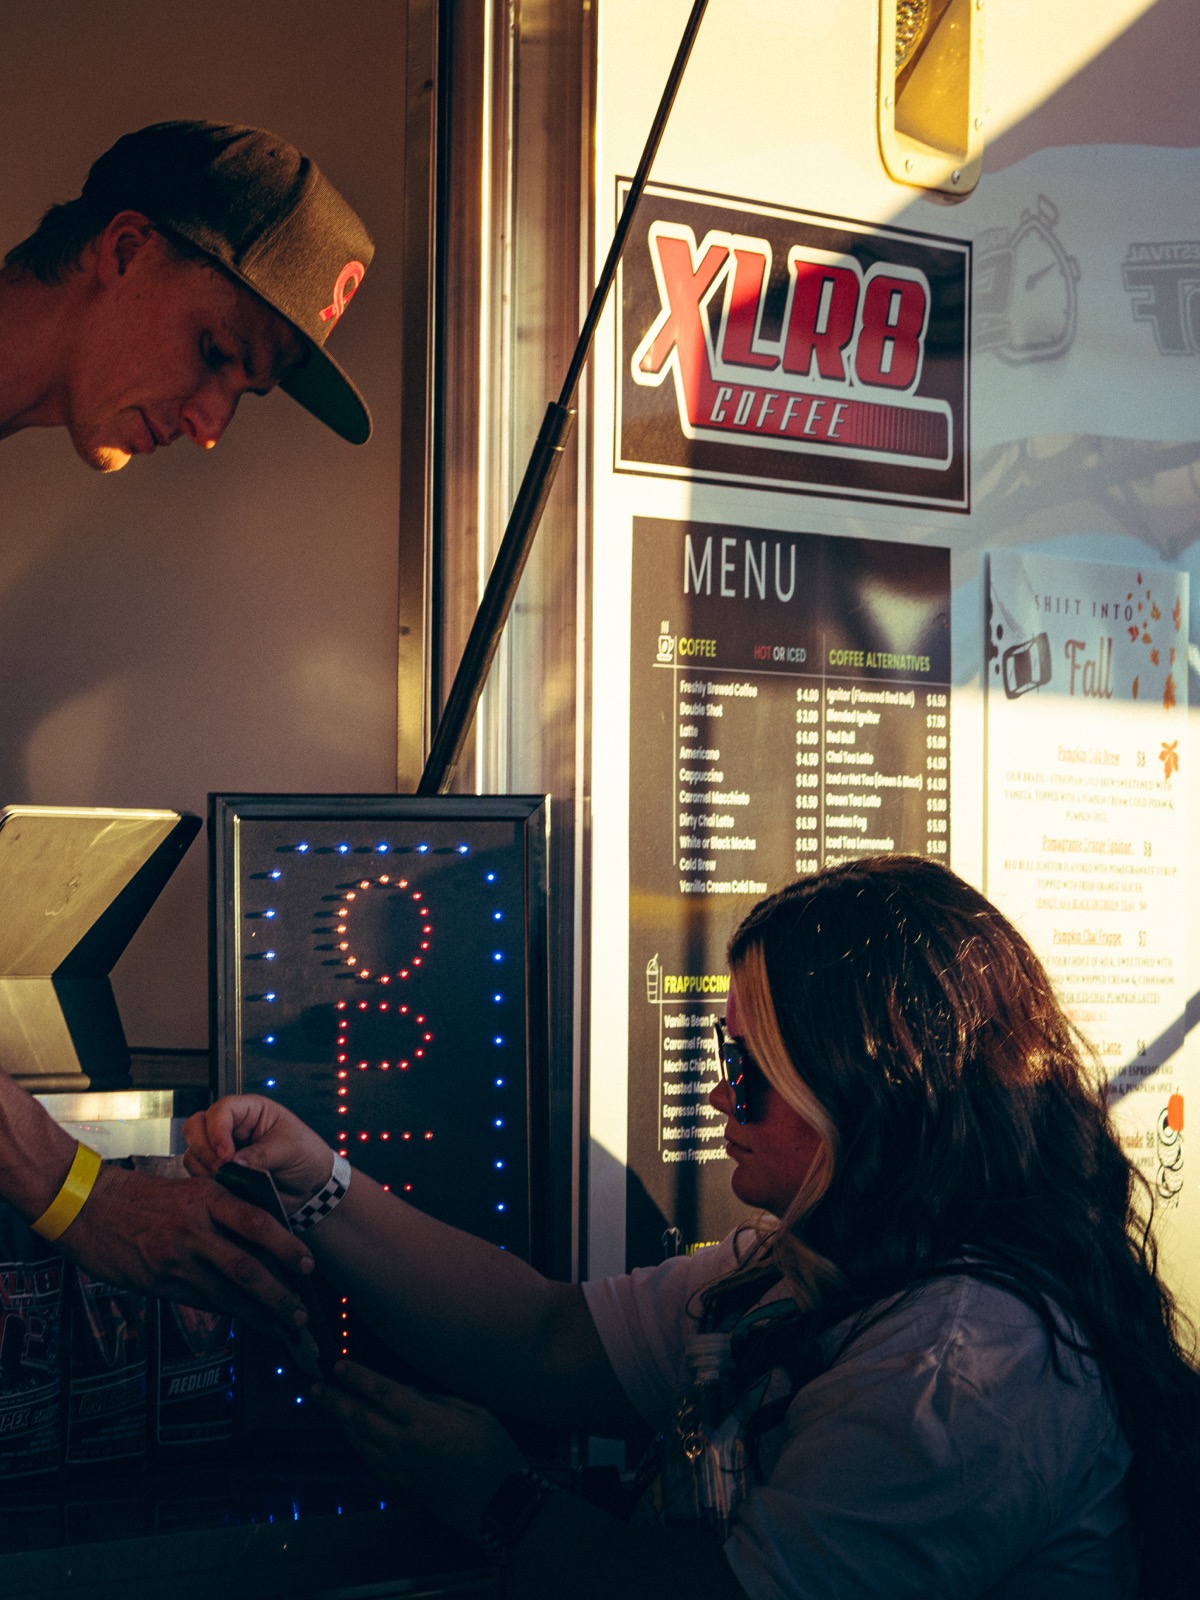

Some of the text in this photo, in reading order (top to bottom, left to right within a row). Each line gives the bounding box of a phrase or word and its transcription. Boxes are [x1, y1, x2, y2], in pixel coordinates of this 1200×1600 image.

[632, 220, 931, 430] XLR8
[709, 385, 850, 439] COFFEE
[683, 533, 797, 602] MENU
[1034, 594, 1134, 622] SHIFT INTO
[678, 638, 717, 659] COFFEE
[754, 644, 807, 663] HOT OR ICED
[829, 649, 931, 673] COFFEE ALTERNATIVES
[1063, 636, 1114, 700] Fall
[680, 680, 707, 698] Freshly
[707, 681, 734, 697] Brewed
[734, 683, 758, 698] Coffee
[680, 702, 706, 717] Double
[706, 703, 724, 718] Shot
[680, 724, 699, 738] Latte
[826, 729, 841, 744] Red
[680, 746, 721, 761] Americano
[826, 749, 843, 763] Chai
[843, 751, 856, 764] Tea
[856, 751, 874, 765] Latte
[680, 768, 724, 785] Cappuccino
[861, 773, 874, 786] Tea
[680, 790, 712, 804] Caramel
[712, 790, 751, 806] Macchiato
[825, 792, 848, 807] Green
[848, 793, 862, 807] Tea
[862, 794, 882, 808] Latte
[680, 813, 698, 831] Dirty
[698, 813, 716, 828] Chai
[715, 814, 735, 829] Latte
[825, 814, 853, 829] London
[853, 815, 868, 833] Fog
[680, 835, 701, 849] White
[702, 838, 711, 850] or
[731, 836, 757, 851] Mocha
[842, 836, 857, 850] Tea
[856, 836, 895, 851] Lemonade
[680, 857, 698, 872] Cold
[698, 858, 717, 872] Brew
[680, 879, 768, 894] Vanilla Cream Cold Brew
[664, 975, 731, 994] FRAPPUCCIN
[664, 1013, 690, 1029] Vanilla
[691, 1014, 709, 1028] Bean
[664, 1037, 696, 1051] Caramel
[663, 1058, 689, 1074] Mocha
[690, 1057, 706, 1076] Chip
[663, 1081, 692, 1096] Toasted
[663, 1126, 690, 1141] Matcha
[662, 1149, 688, 1163] Cream
[167, 1366, 222, 1396] REDLINE
